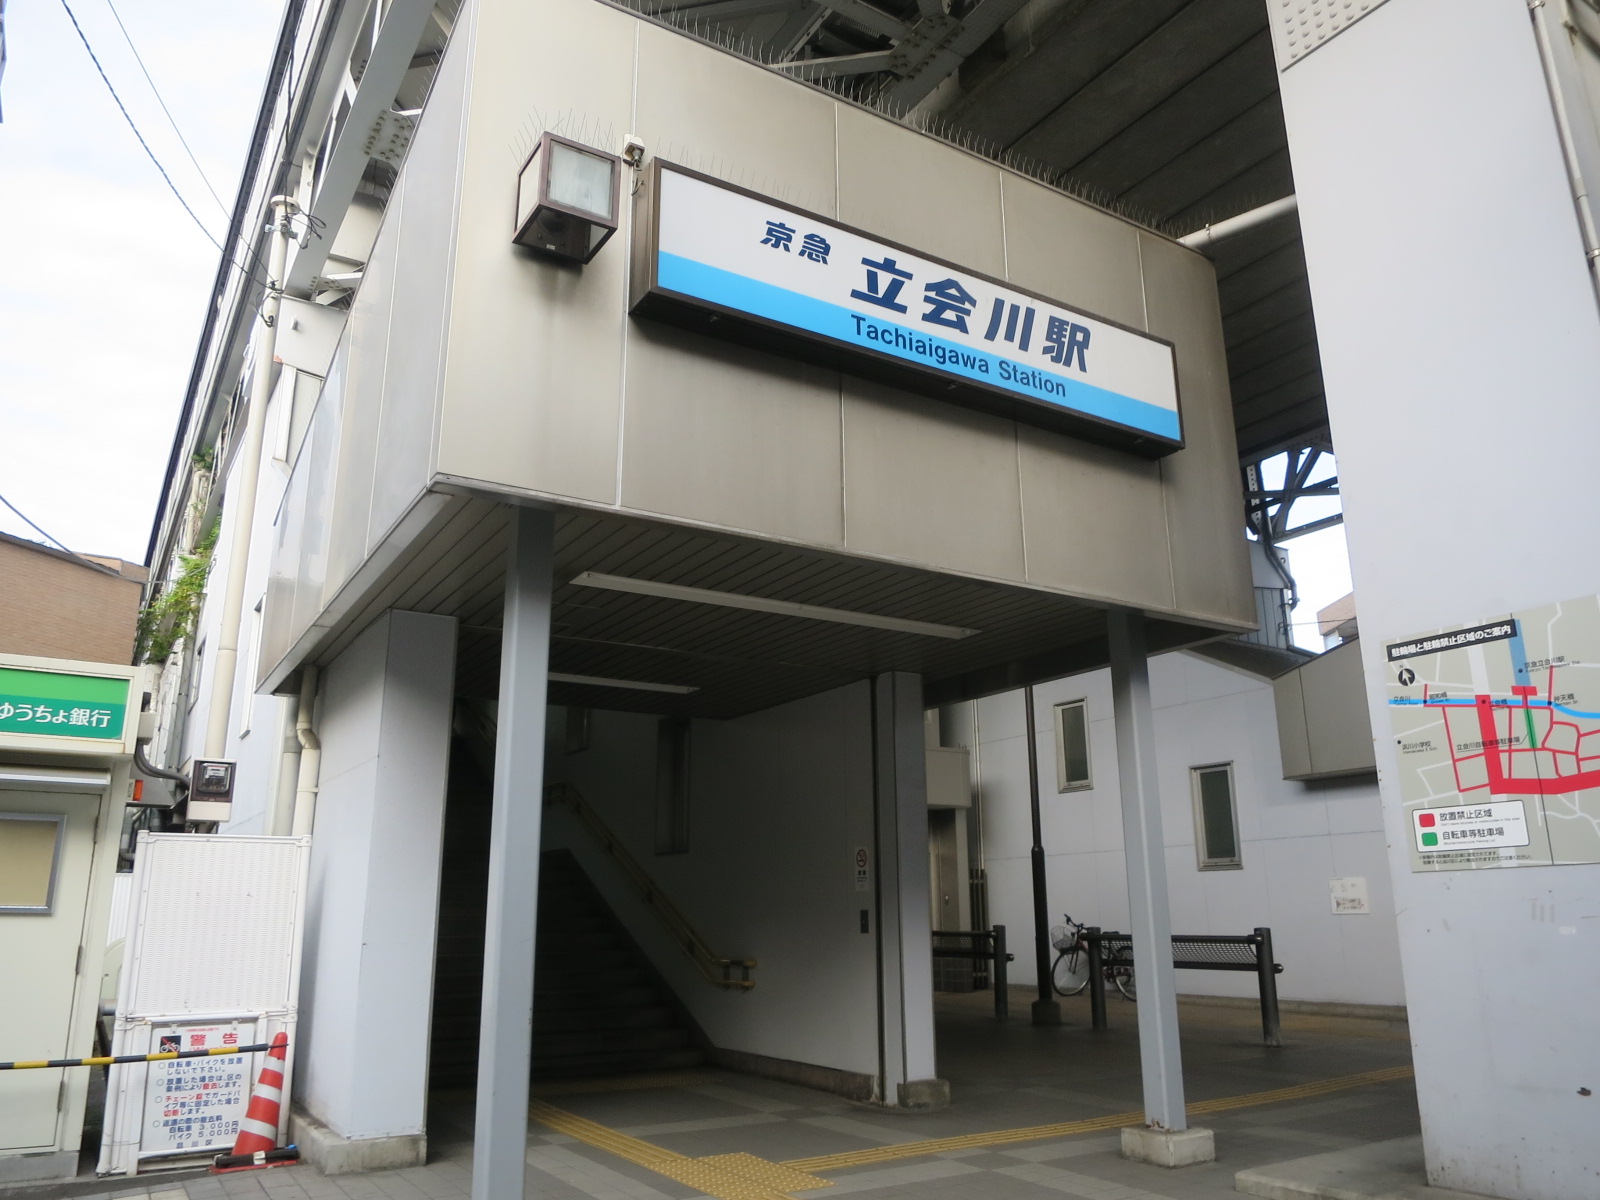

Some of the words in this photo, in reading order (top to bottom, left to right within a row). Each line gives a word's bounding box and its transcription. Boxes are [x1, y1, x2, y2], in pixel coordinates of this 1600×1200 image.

[760, 220, 831, 265] 京急
[850, 257, 1092, 373] 立会川駅
[851, 314, 990, 374] Tachiaigawa
[998, 360, 1066, 397] Station
[1391, 625, 1511, 658] 駐輪場と駐輪禁止区域のご案内
[0, 702, 112, 728] ゆうちょ銀行
[1439, 808, 1493, 821] 放置禁止区域
[1442, 827, 1505, 840] 自転車等駐車場
[168, 1132, 192, 1141] バイク
[169, 1125, 193, 1134] 自転車
